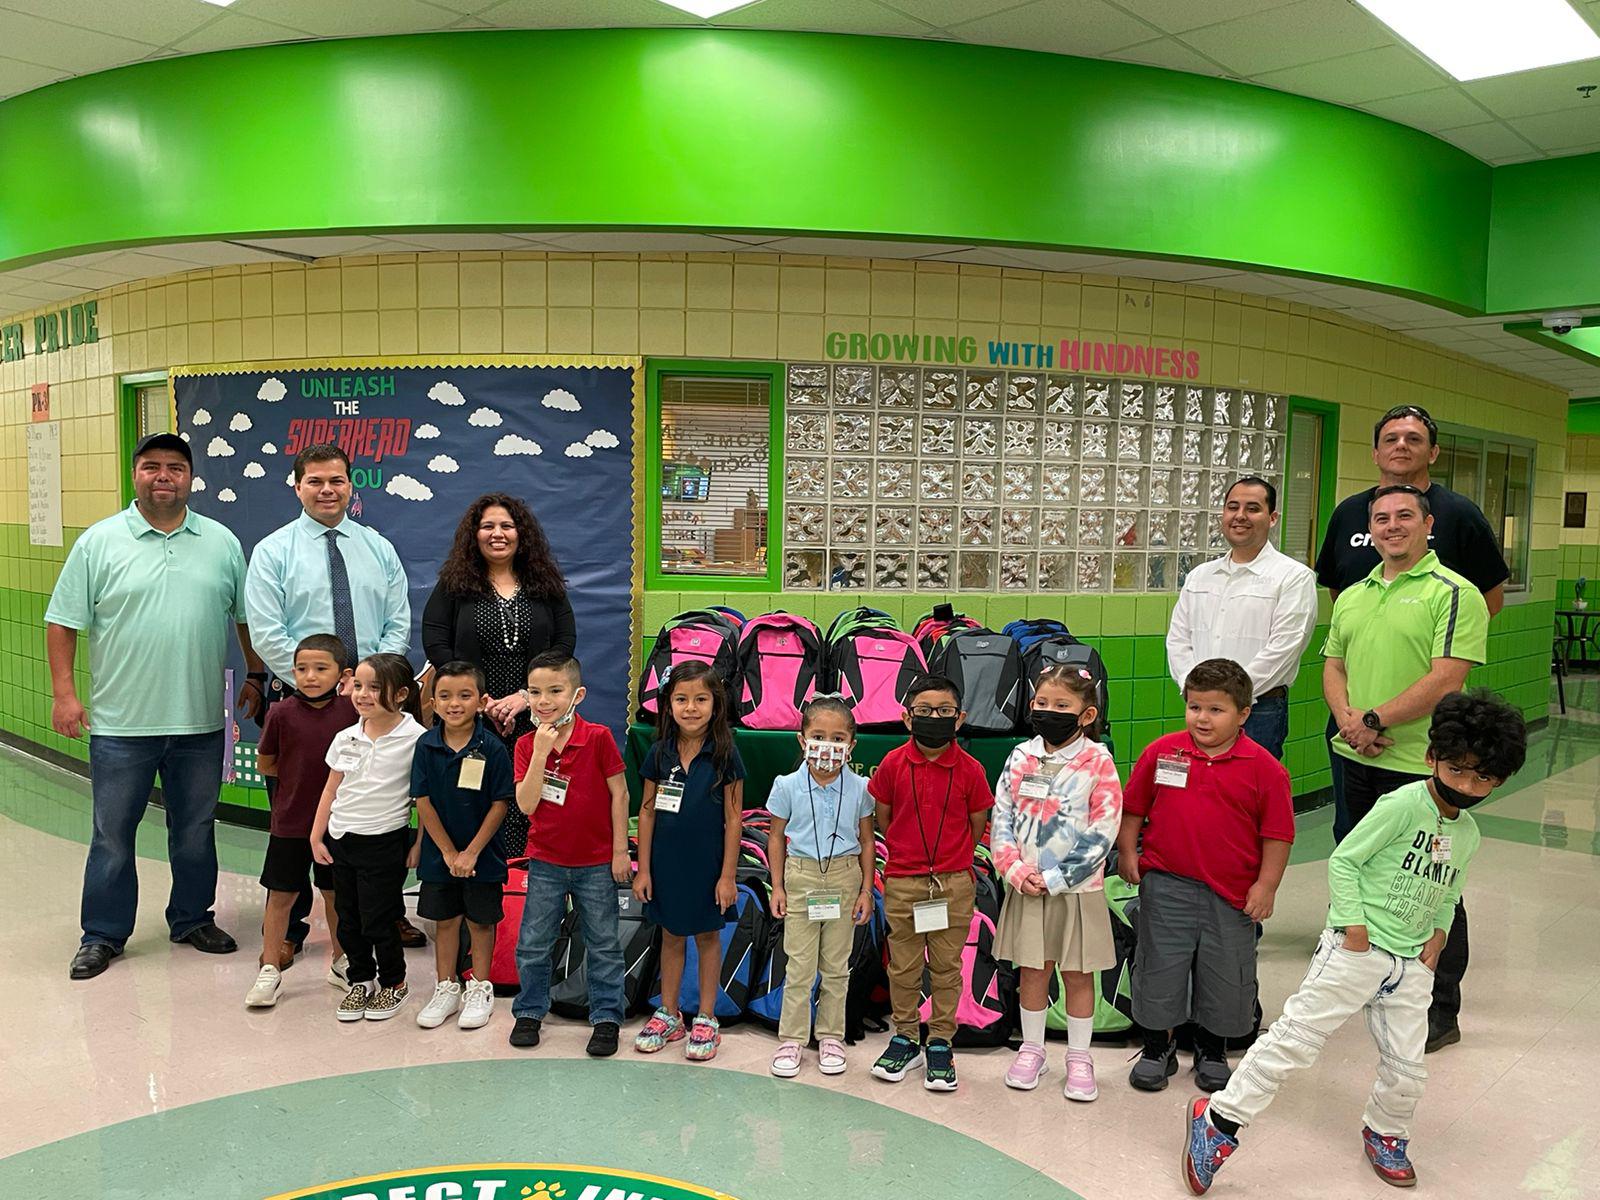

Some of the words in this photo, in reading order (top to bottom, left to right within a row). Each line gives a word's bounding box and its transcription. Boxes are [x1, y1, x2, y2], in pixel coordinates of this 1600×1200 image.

[0, 324, 24, 363] ER
[34, 301, 99, 355] PRIDE
[826, 332, 977, 364] GROWING
[988, 341, 1054, 369] WITH
[1059, 339, 1200, 379] KINDNESS
[301, 376, 396, 398] UNLEASH
[333, 400, 360, 415] THE
[284, 418, 412, 462] SUPERHERO
[349, 468, 382, 489] OU
[1384, 893, 1419, 925] THE
